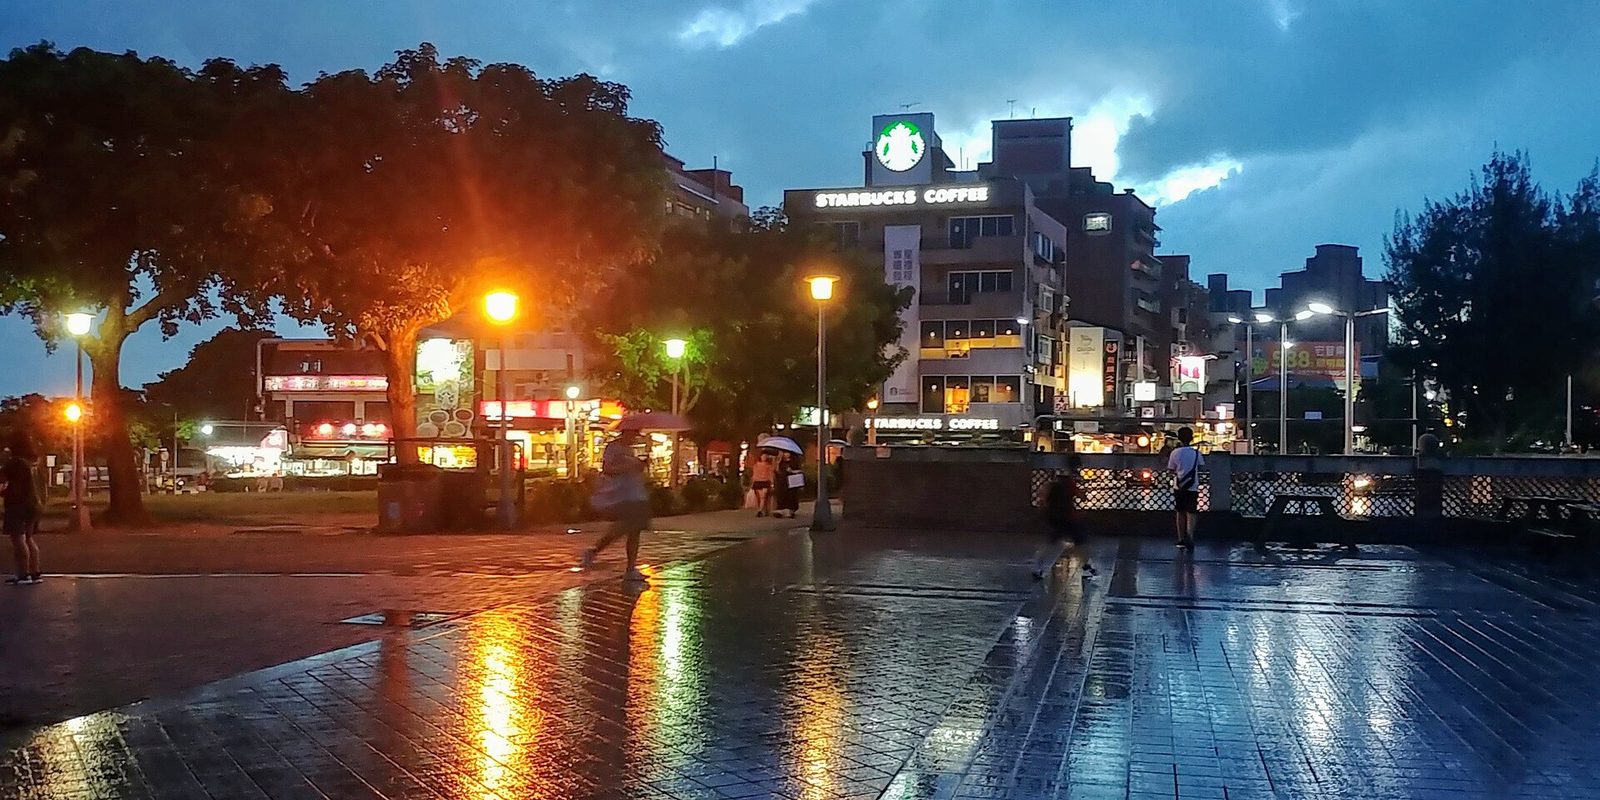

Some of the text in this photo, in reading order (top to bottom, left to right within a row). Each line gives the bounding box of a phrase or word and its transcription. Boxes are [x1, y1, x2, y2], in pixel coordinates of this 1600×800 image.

[815, 187, 989, 208] STARBUCKS COFFEE
[865, 418, 999, 430] STARBUCKS COFFEE
